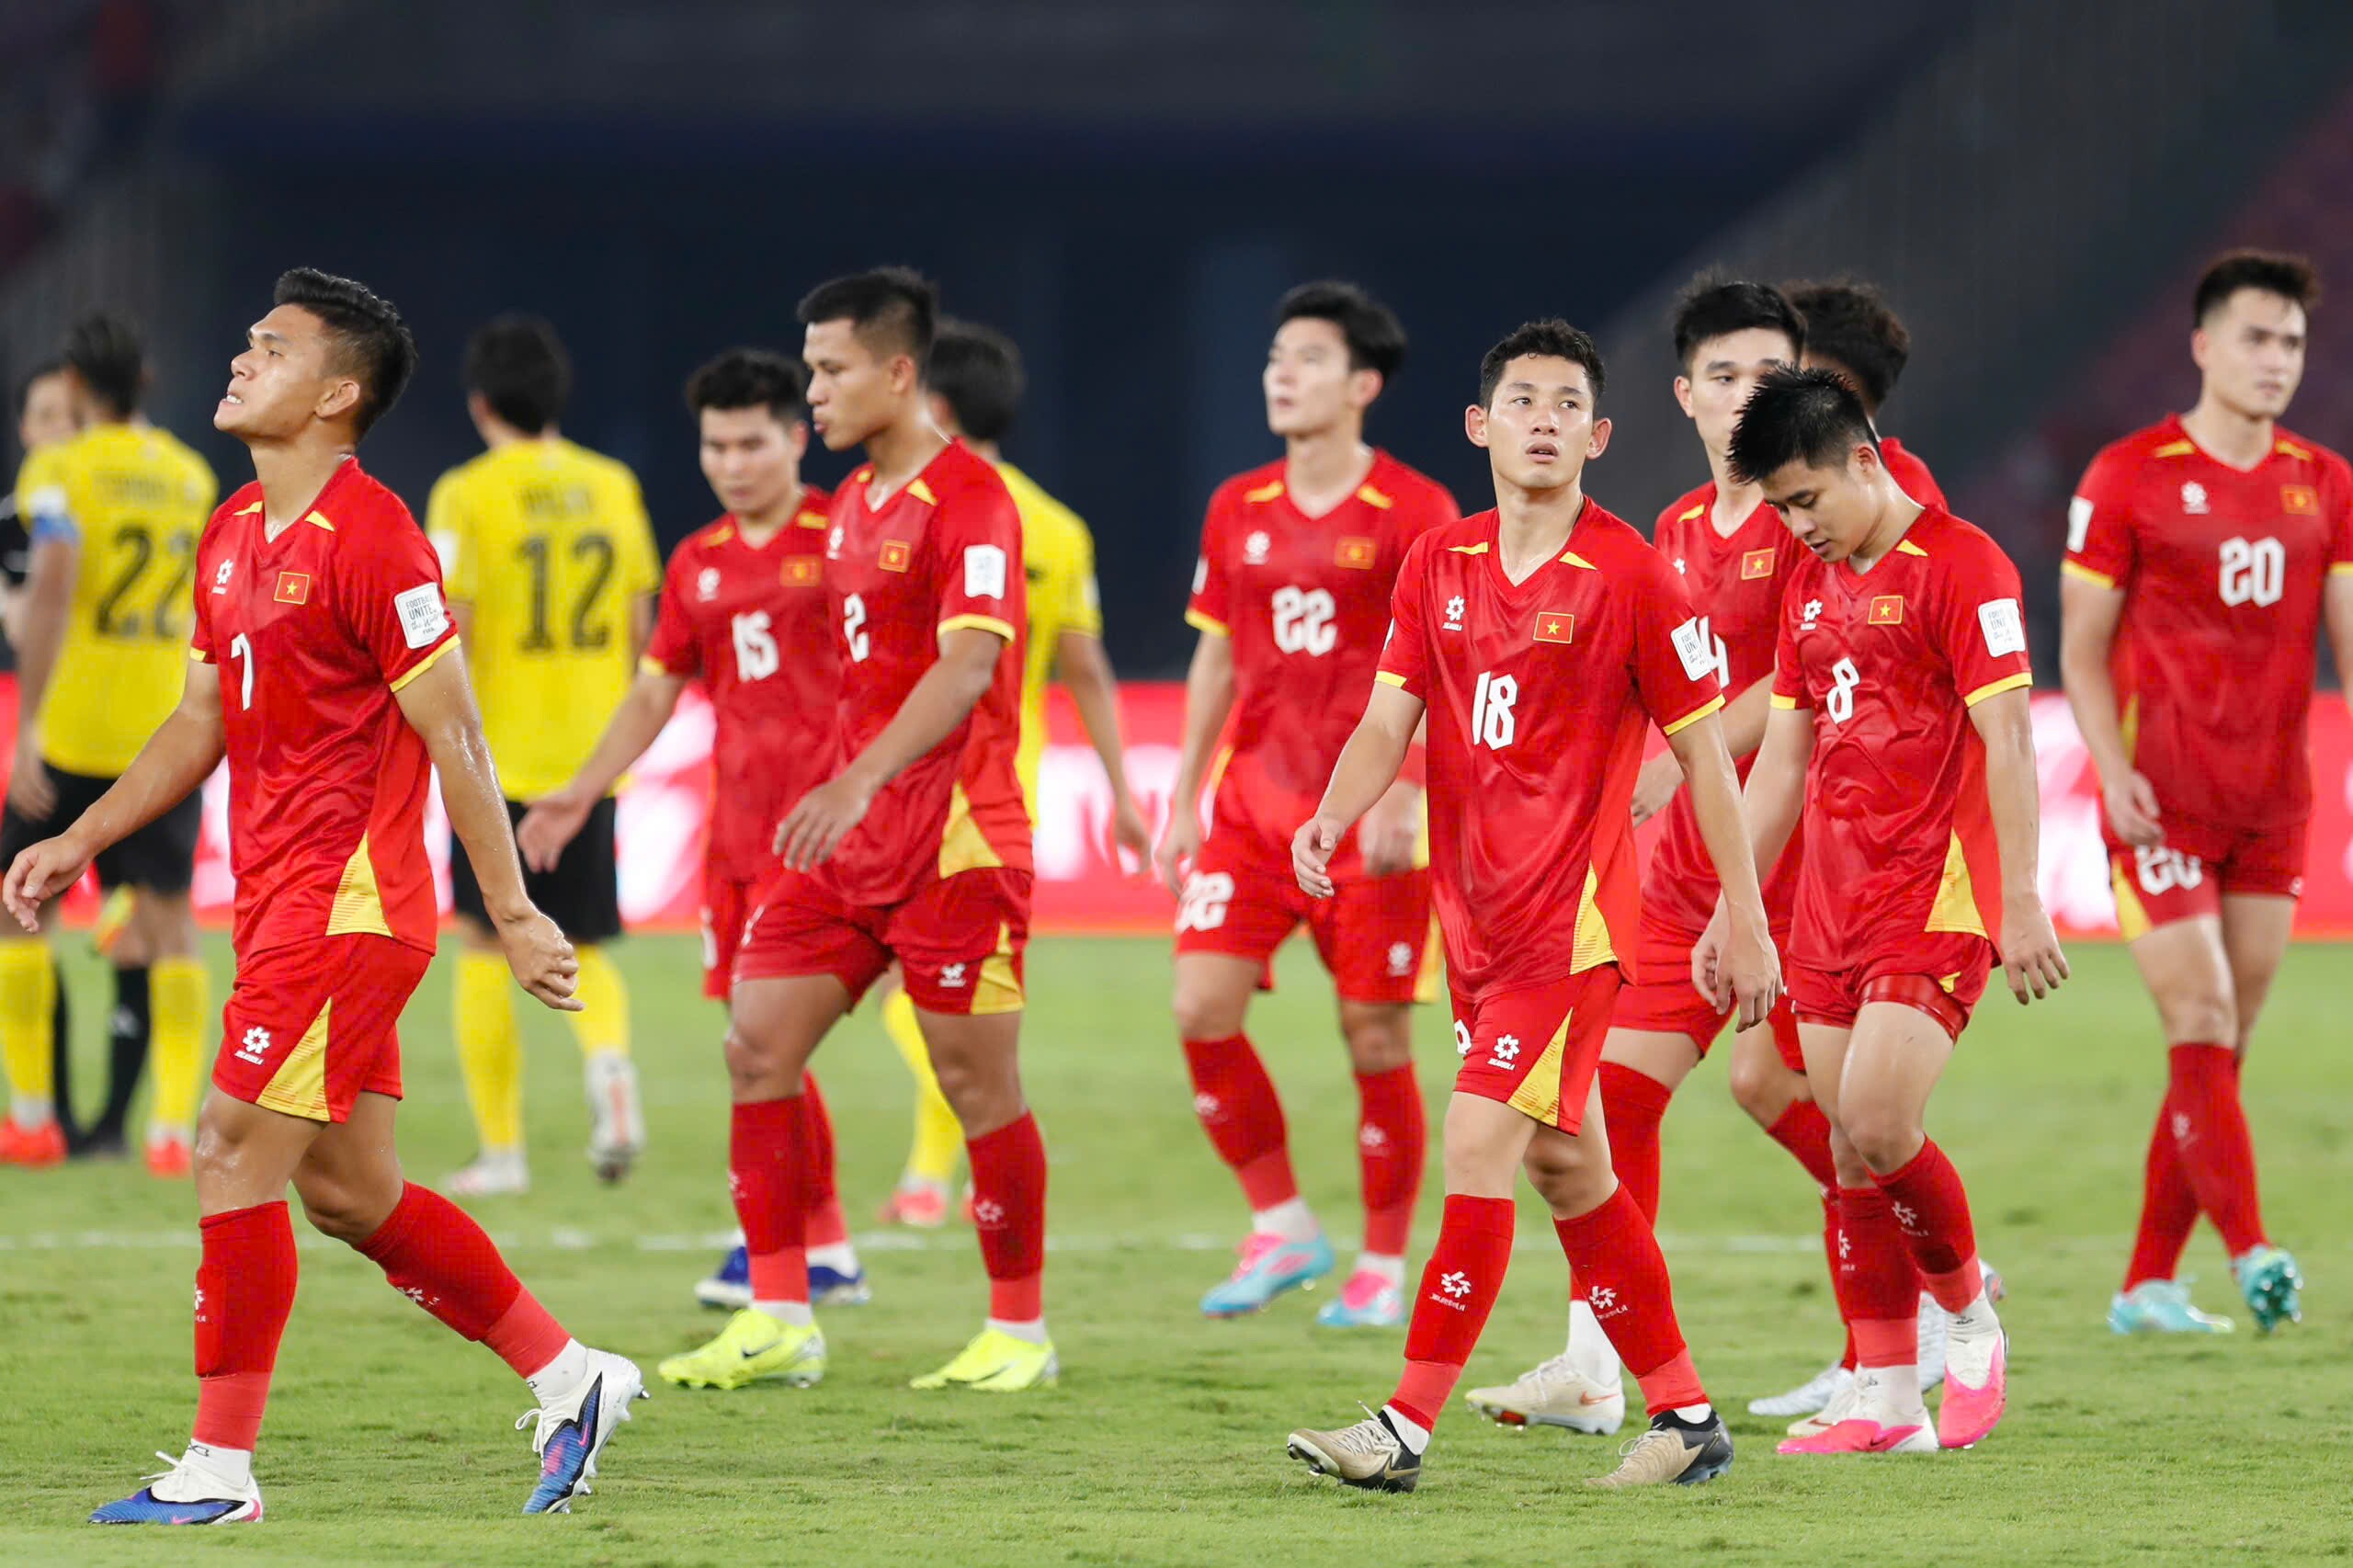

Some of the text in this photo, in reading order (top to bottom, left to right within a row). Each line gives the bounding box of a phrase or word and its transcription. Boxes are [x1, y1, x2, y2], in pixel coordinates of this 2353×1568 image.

[512, 533, 615, 650] 12
[2218, 536, 2288, 608] 20
[732, 610, 779, 683] 15
[844, 592, 870, 663] 2
[1270, 585, 1338, 658] 22
[230, 632, 254, 711] 7
[1825, 656, 1860, 724] 8
[1472, 670, 1518, 751] 18
